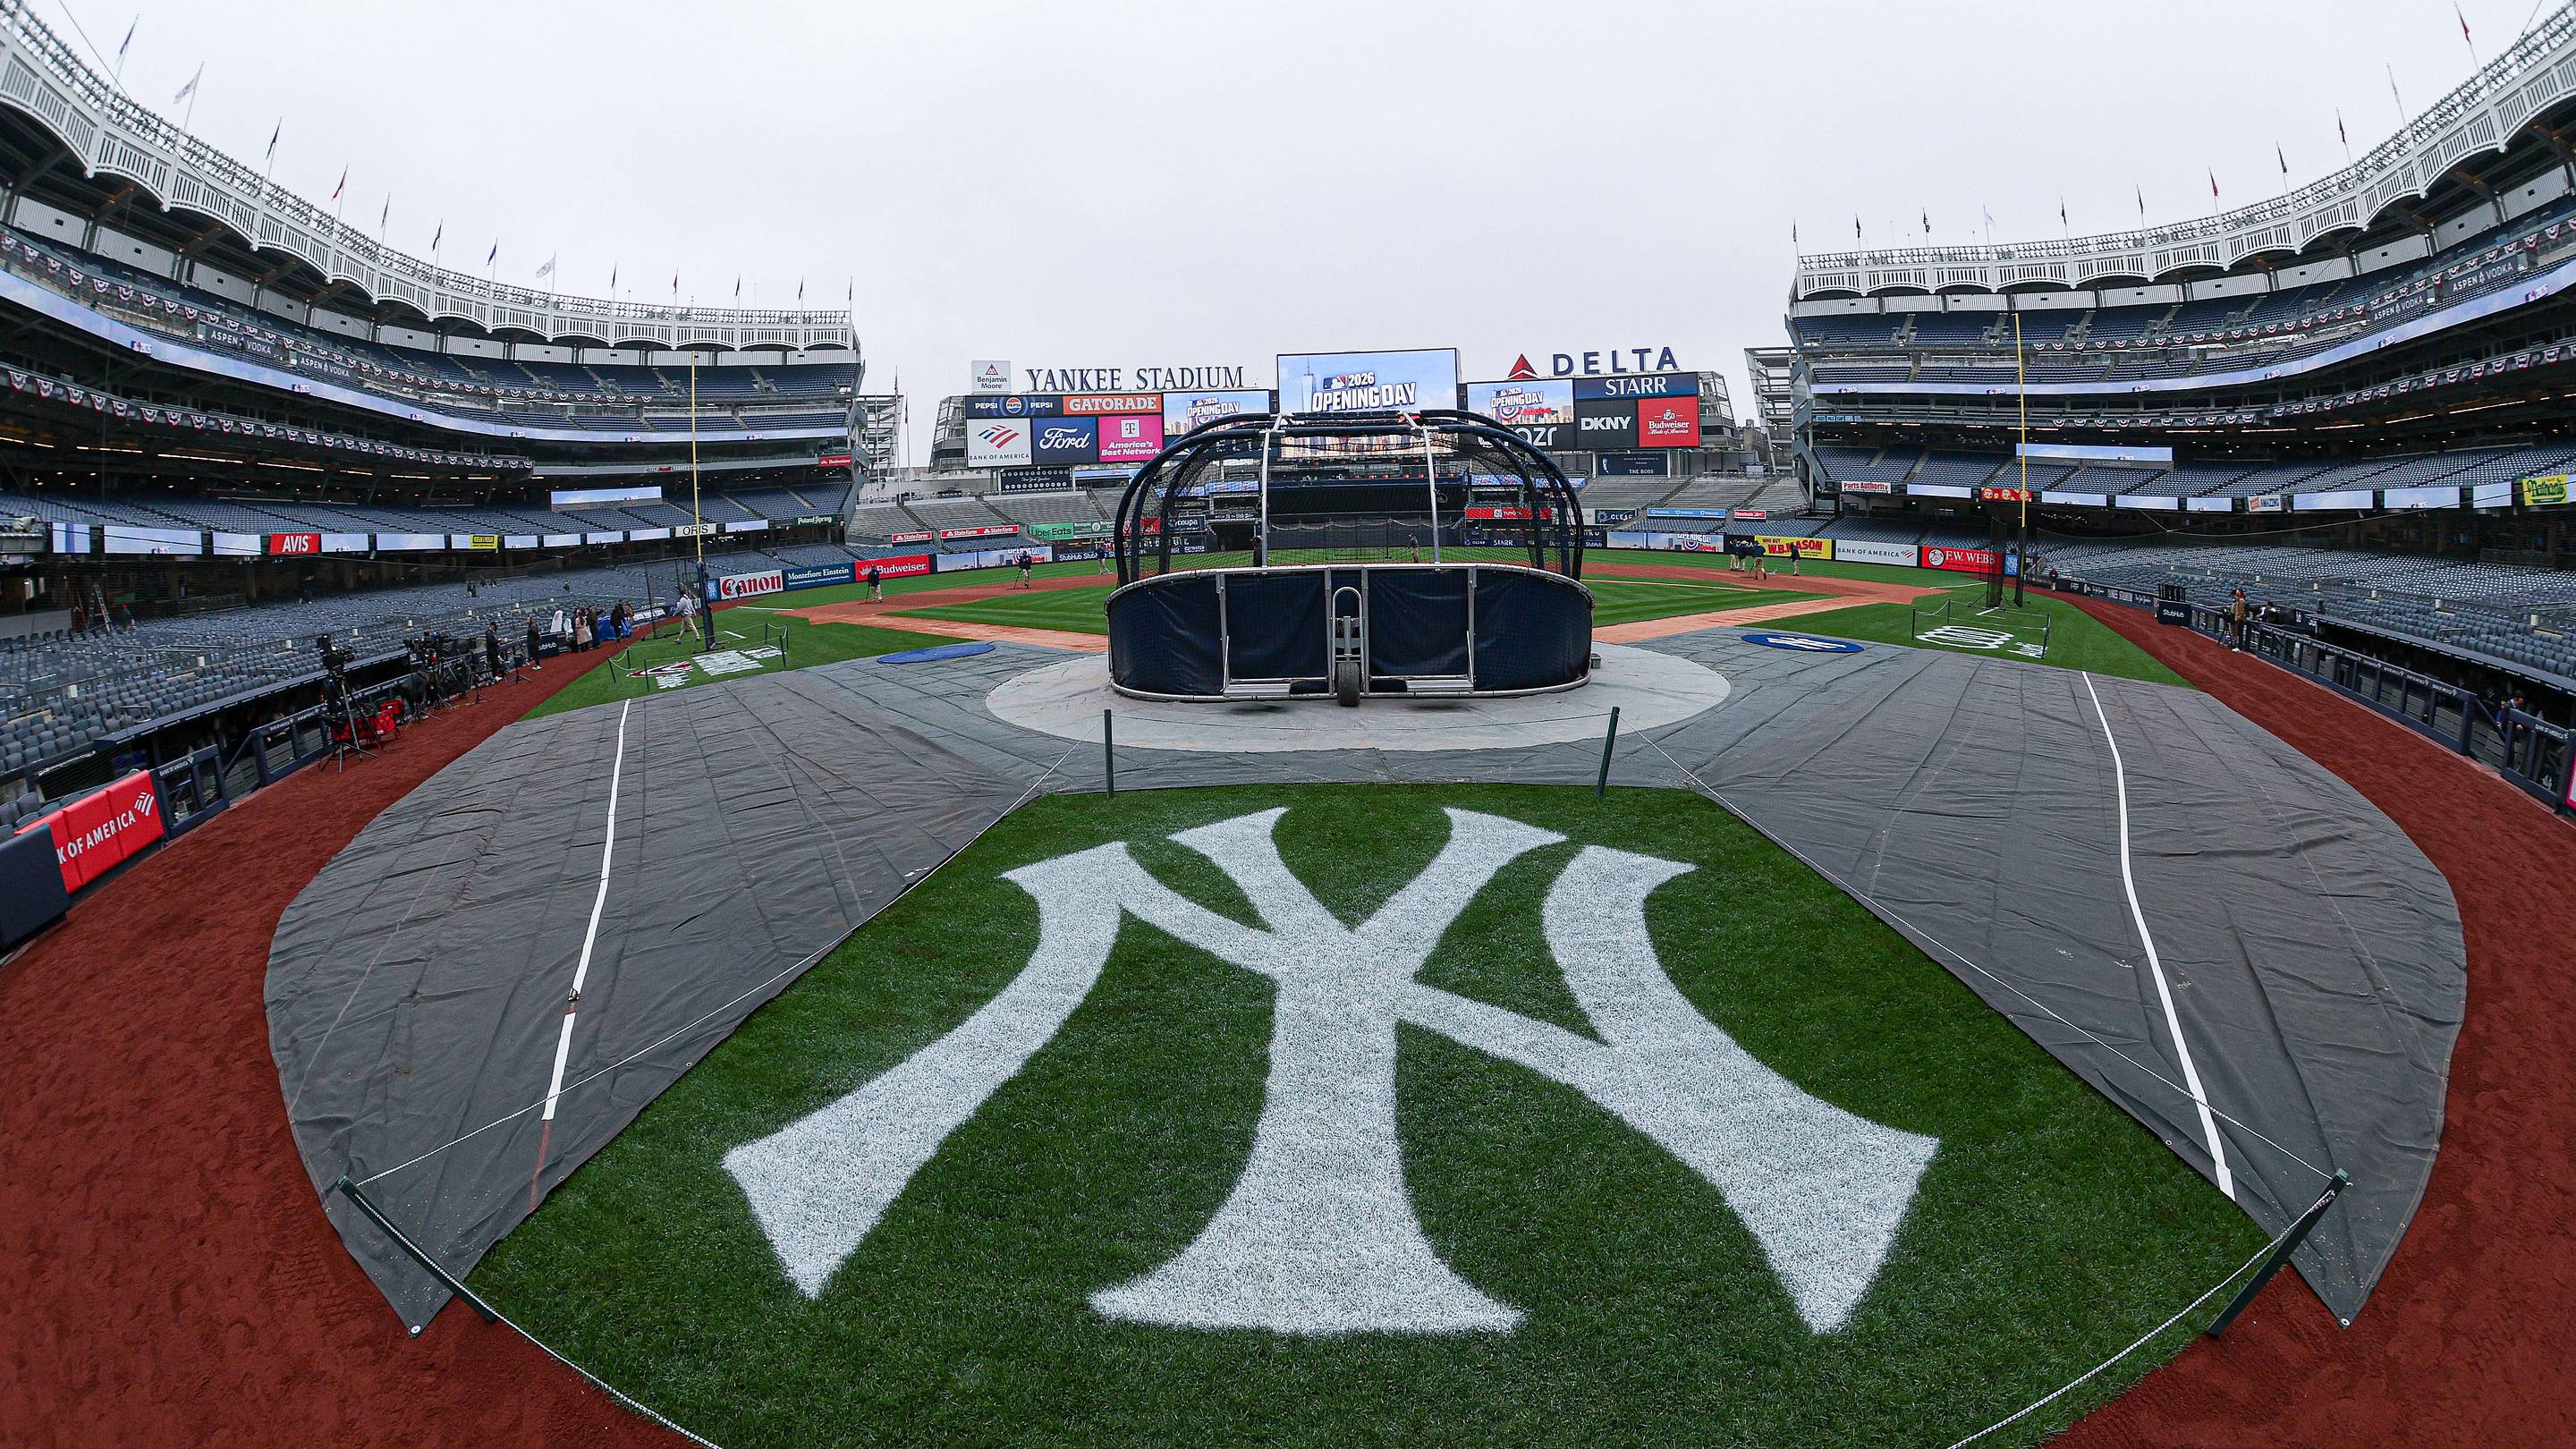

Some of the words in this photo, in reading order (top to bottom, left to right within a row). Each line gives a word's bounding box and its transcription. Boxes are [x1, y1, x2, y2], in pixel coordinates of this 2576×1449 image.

[2453, 276, 2478, 292] ASPEN
[2487, 264, 2514, 280] VODKA
[2374, 306, 2395, 321] ASPEN
[2402, 295, 2424, 310] VODKA
[210, 330, 238, 345] ASPEN
[247, 340, 271, 354] VODKA
[300, 357, 323, 369] ASPEN
[329, 365, 350, 377] VODKA
[1553, 346, 1679, 377] DELTA
[977, 376, 1007, 384] Benjamin
[1025, 368, 1123, 392] YANKEE
[1136, 366, 1244, 390] STADIUM
[1348, 371, 1375, 387] 2026
[1605, 376, 1667, 395] STARR
[1312, 387, 1380, 411] OPENING
[1381, 382, 1417, 407] DAY
[1508, 386, 1522, 394] 2026
[1069, 396, 1157, 411] GATORADE
[1205, 396, 1218, 404] 2026
[1491, 395, 1525, 408] OPENING
[1525, 391, 1543, 405] DAY
[1187, 403, 1220, 417] OPENING
[1221, 402, 1240, 414] DAY
[1580, 416, 1631, 430] DKNY
[1648, 420, 1690, 429] Budweiser
[1039, 428, 1090, 450] Ford
[1513, 427, 1557, 446] azr
[1108, 439, 1154, 449] America's
[1101, 447, 1122, 457] Best
[1122, 447, 1161, 455] Network
[1860, 482, 1889, 491] Authority
[798, 516, 814, 525] Poland
[813, 515, 832, 524] Spring
[682, 524, 708, 536] ORIS
[1031, 526, 1051, 538] Uber
[1052, 526, 1072, 536] Eats
[281, 534, 309, 554] AVIS
[1059, 553, 1081, 562] StubHub
[1868, 549, 1900, 557] AMERICA
[1945, 550, 1964, 562] F.W.
[1966, 552, 1996, 564] WEBB
[787, 571, 822, 580] Montefiore
[822, 566, 850, 577] Einstein
[877, 562, 925, 575] Budweiser
[721, 574, 782, 597] Canon
[2163, 608, 2184, 618] StubHub
[67, 837, 84, 858] OF
[86, 809, 136, 850] AMERICA
